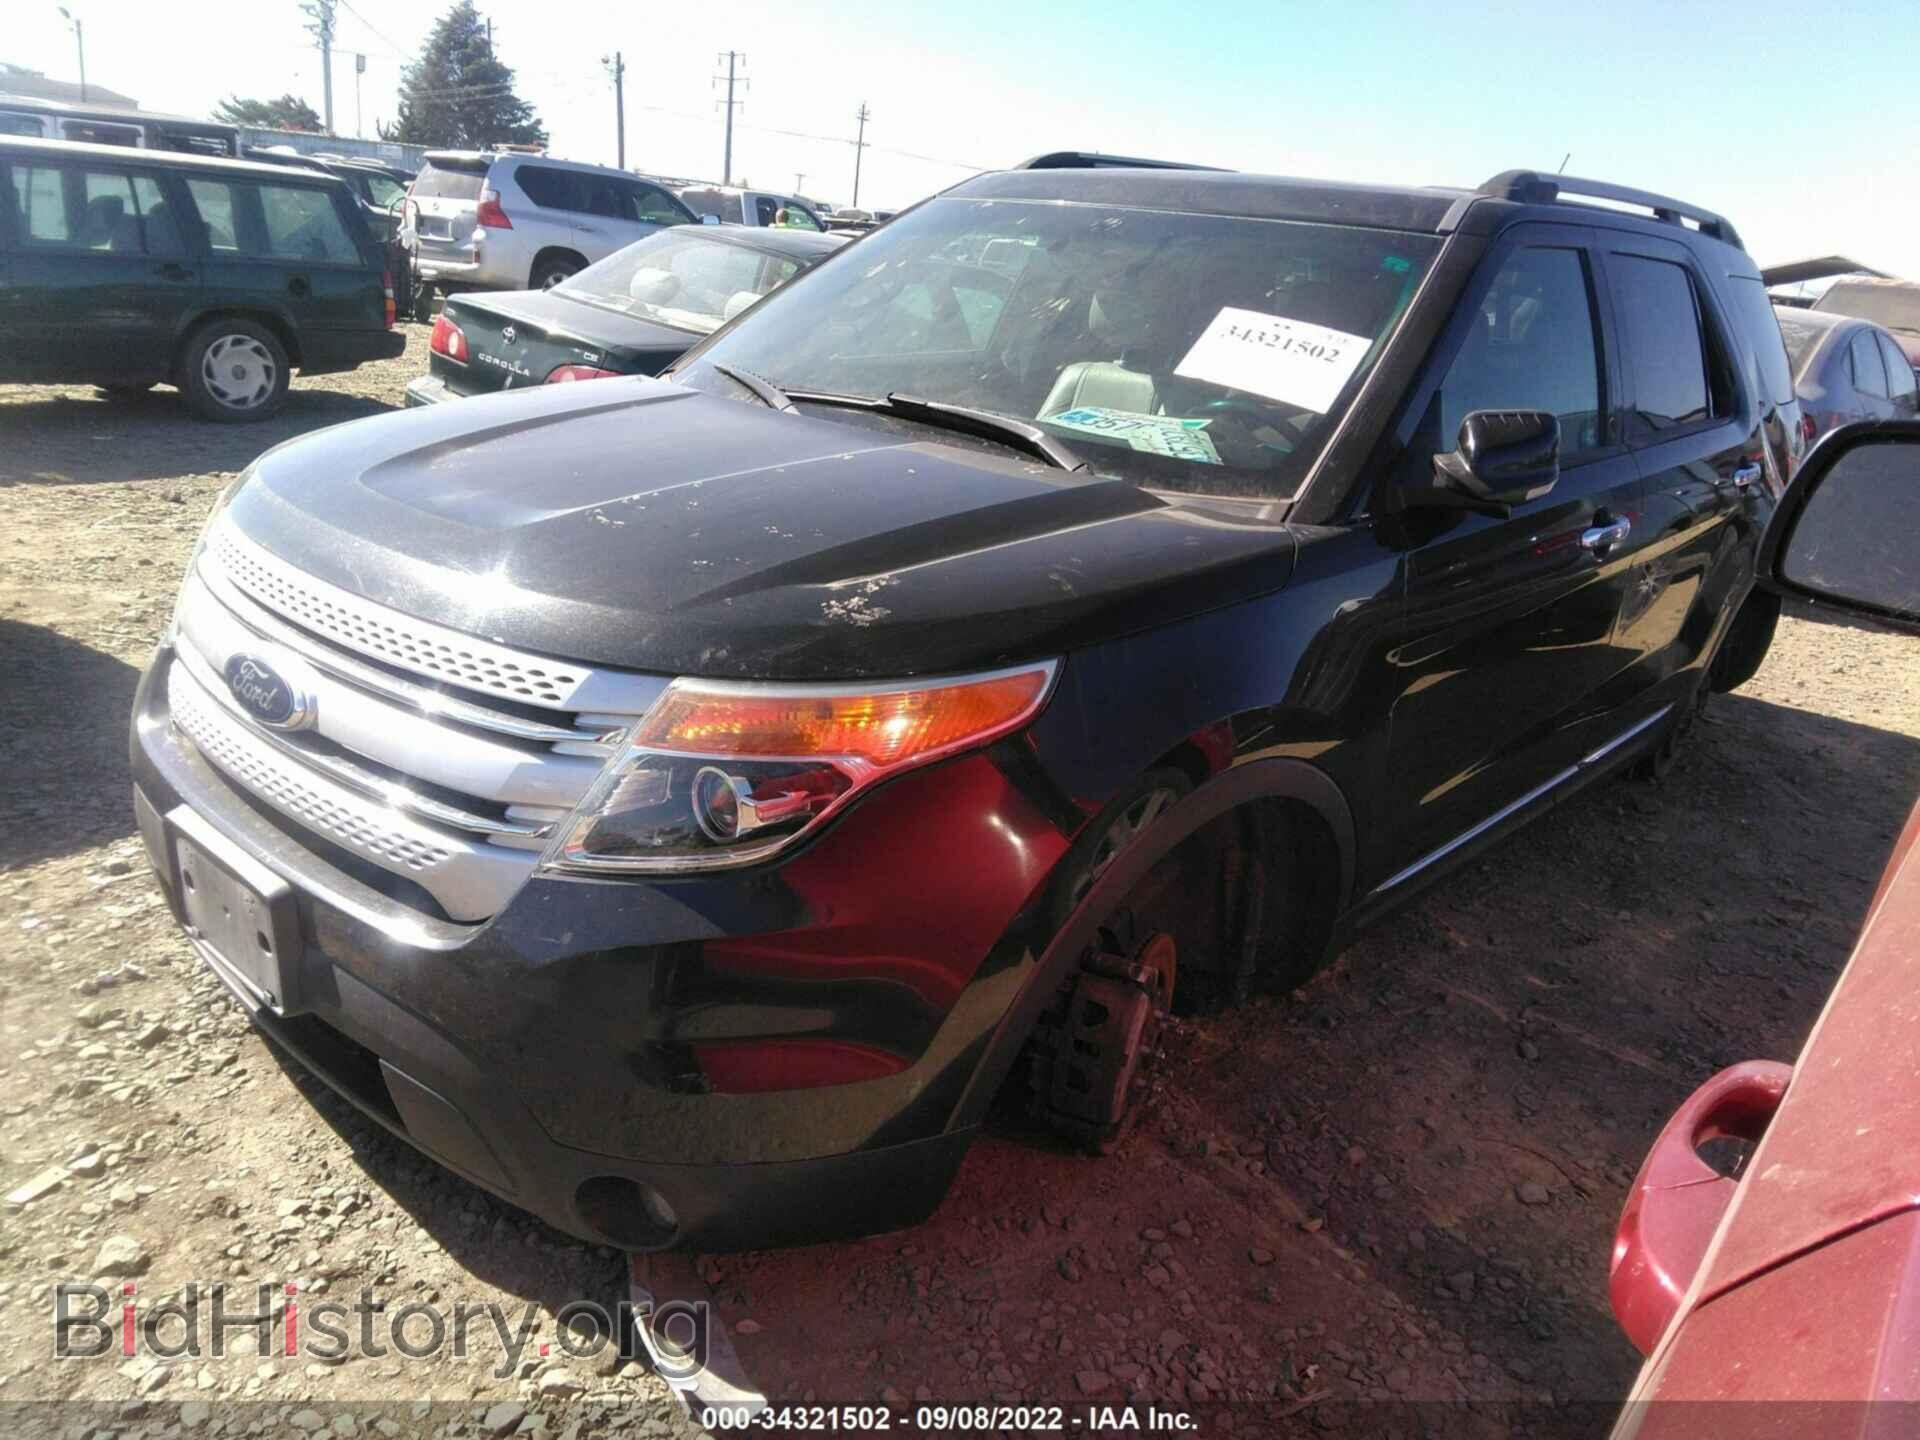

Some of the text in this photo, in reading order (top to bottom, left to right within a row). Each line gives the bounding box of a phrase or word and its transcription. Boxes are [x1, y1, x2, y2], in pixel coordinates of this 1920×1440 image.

[1221, 325, 1340, 362] 34321502
[478, 352, 530, 377] COROLLA
[232, 660, 279, 711] Ford
